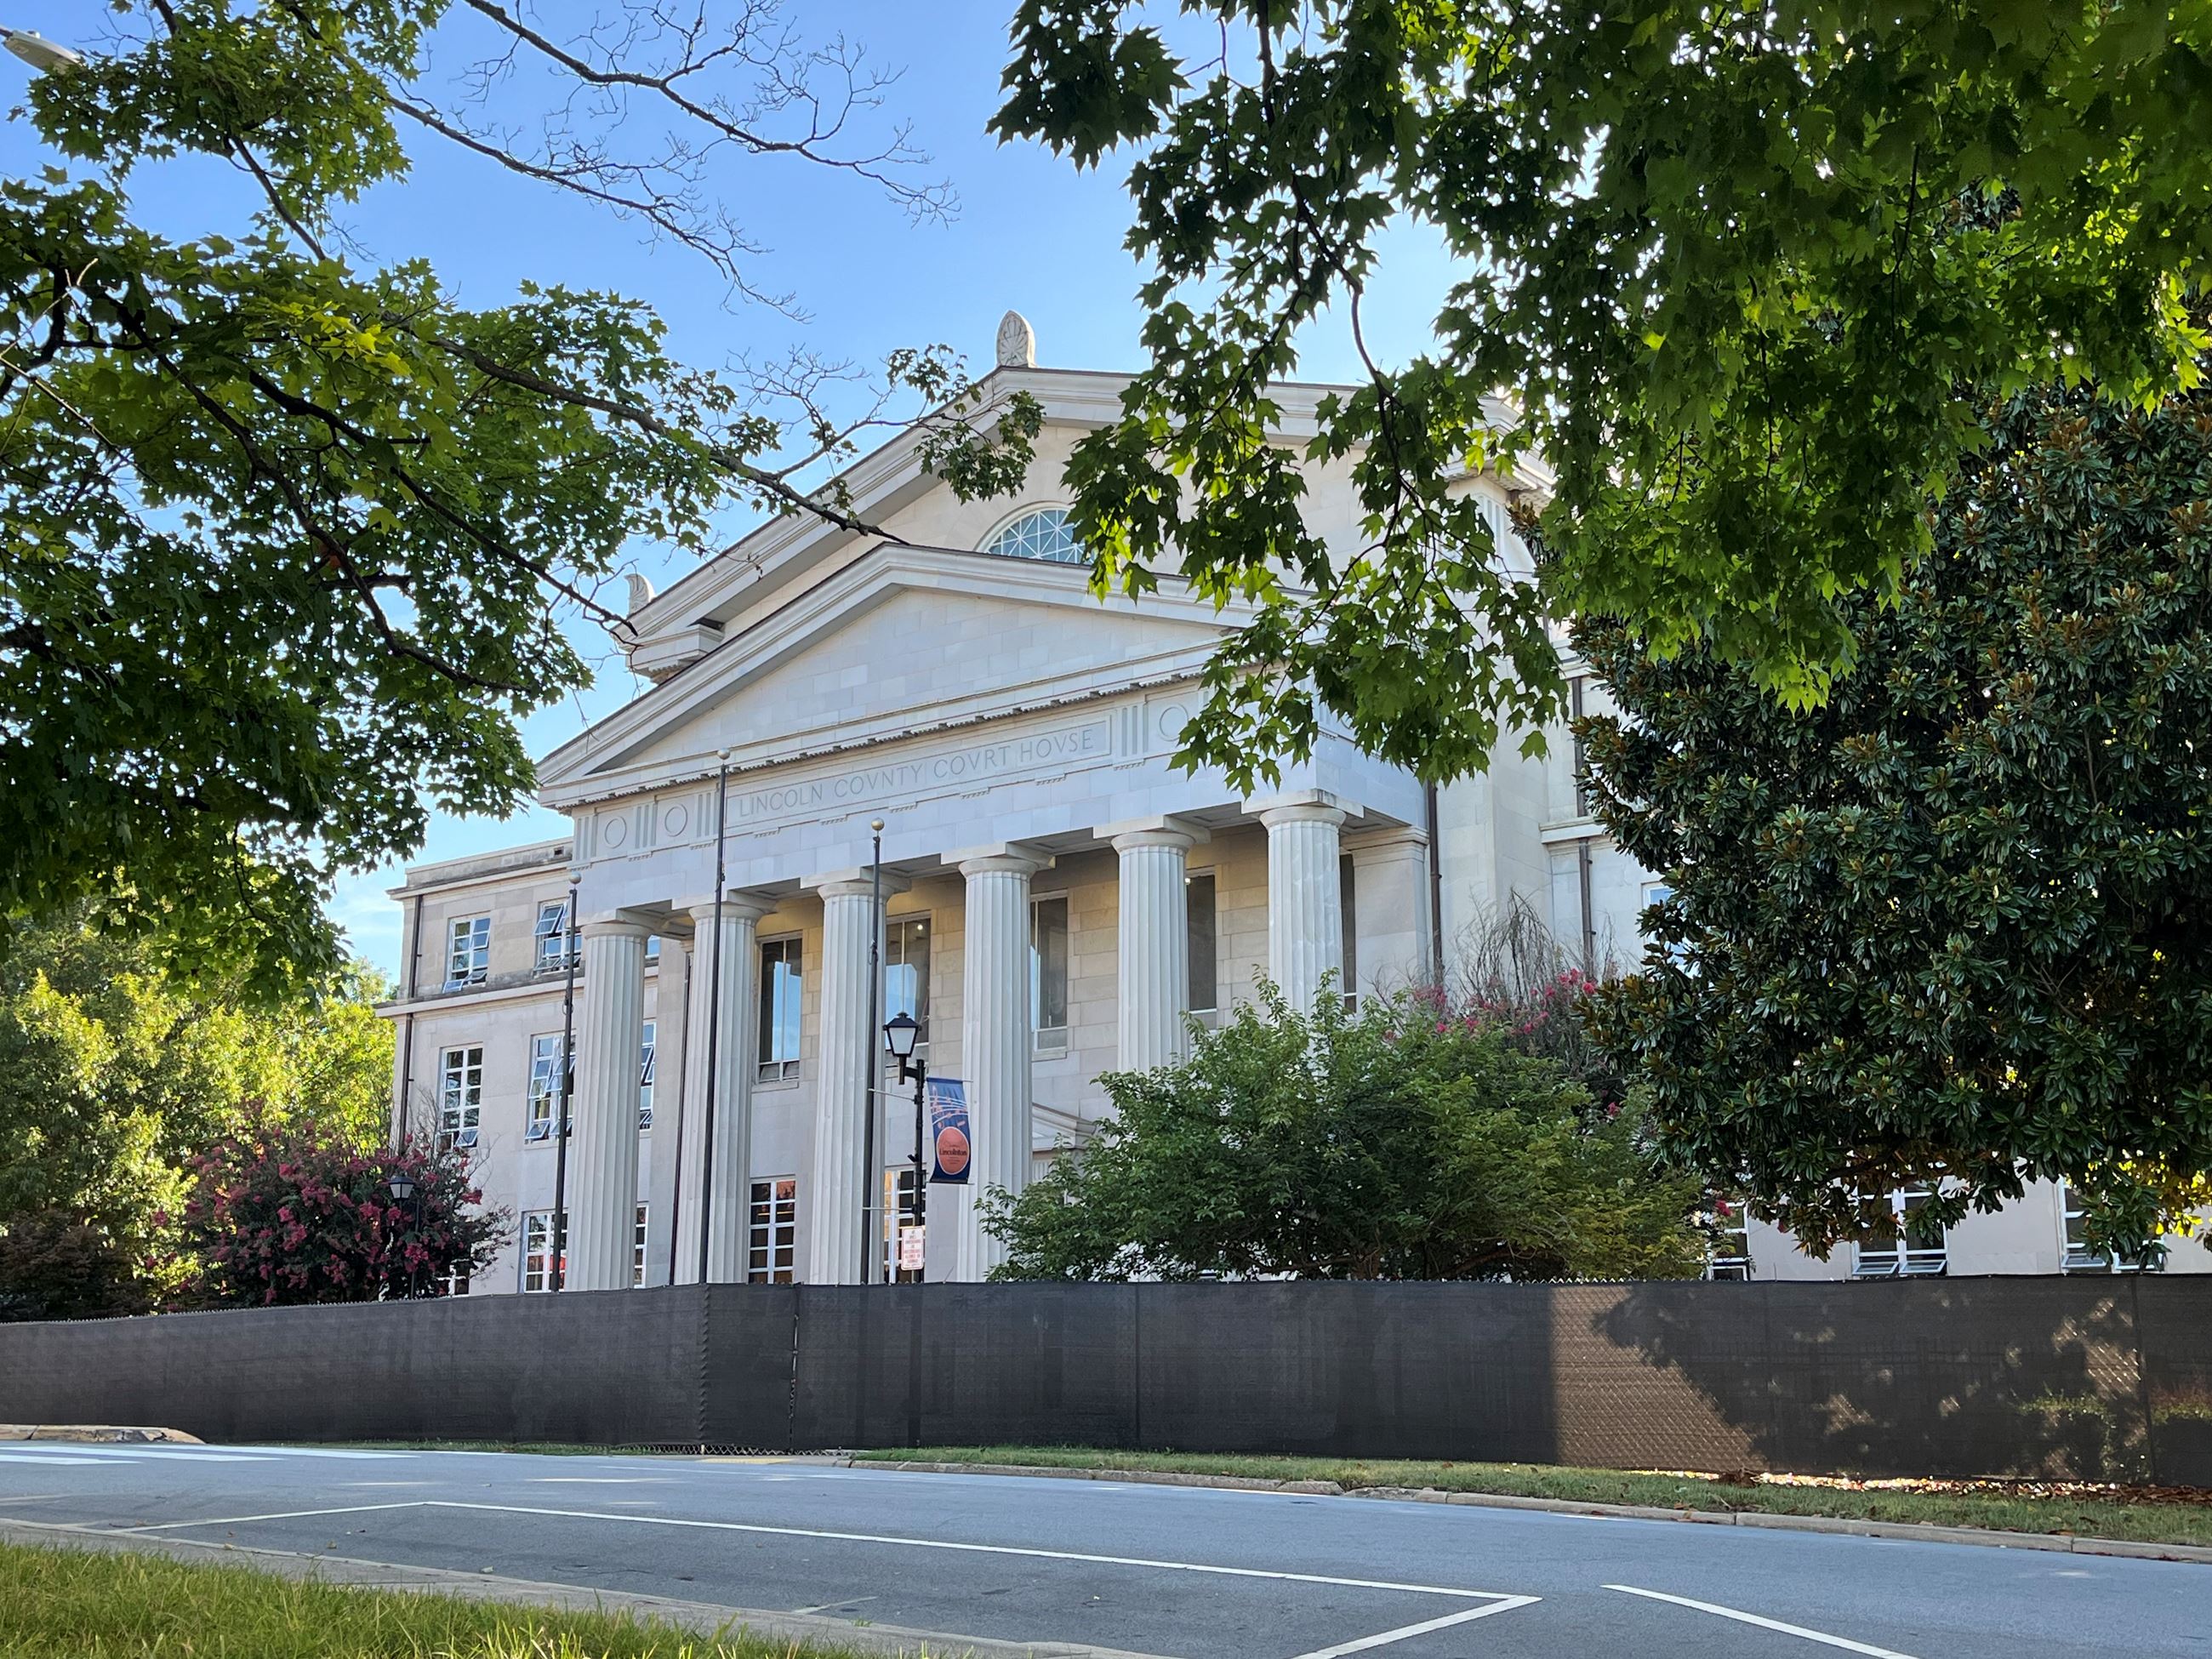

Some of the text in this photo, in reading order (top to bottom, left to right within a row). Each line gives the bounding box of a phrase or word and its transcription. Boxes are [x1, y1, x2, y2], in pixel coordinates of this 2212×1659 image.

[739, 729, 1093, 818] LINCOLN COVNTY COVRT HOVSE
